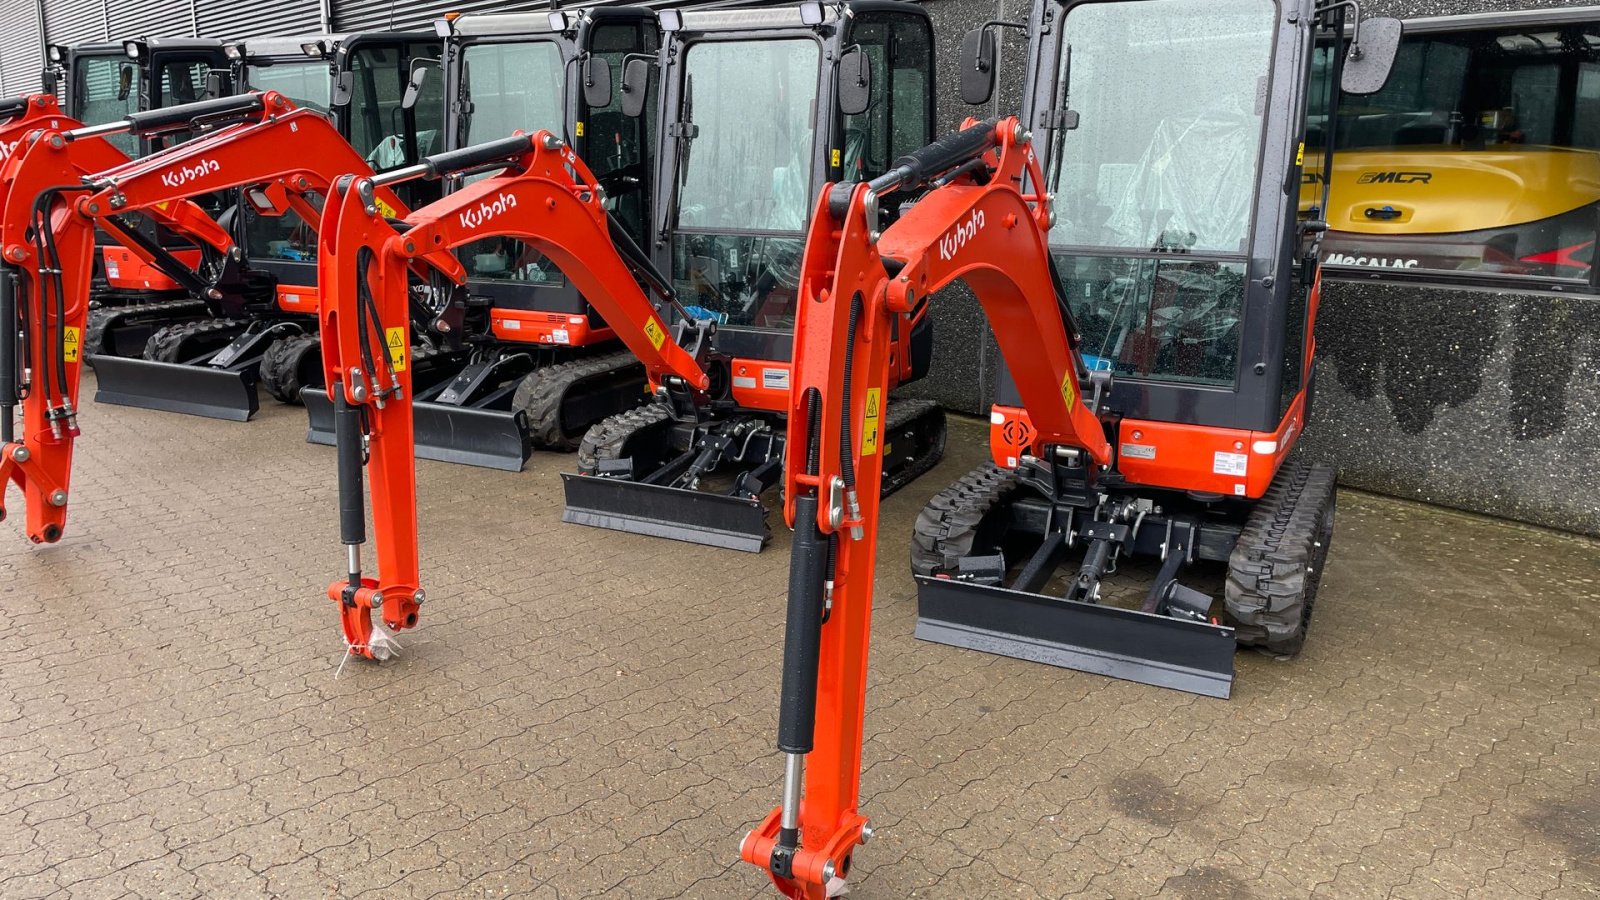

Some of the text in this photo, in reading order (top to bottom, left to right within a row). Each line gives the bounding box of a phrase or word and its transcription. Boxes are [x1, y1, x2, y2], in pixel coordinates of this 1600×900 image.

[161, 159, 221, 187] Kubota
[459, 193, 517, 229] Kubota
[939, 208, 985, 261] Kubota
